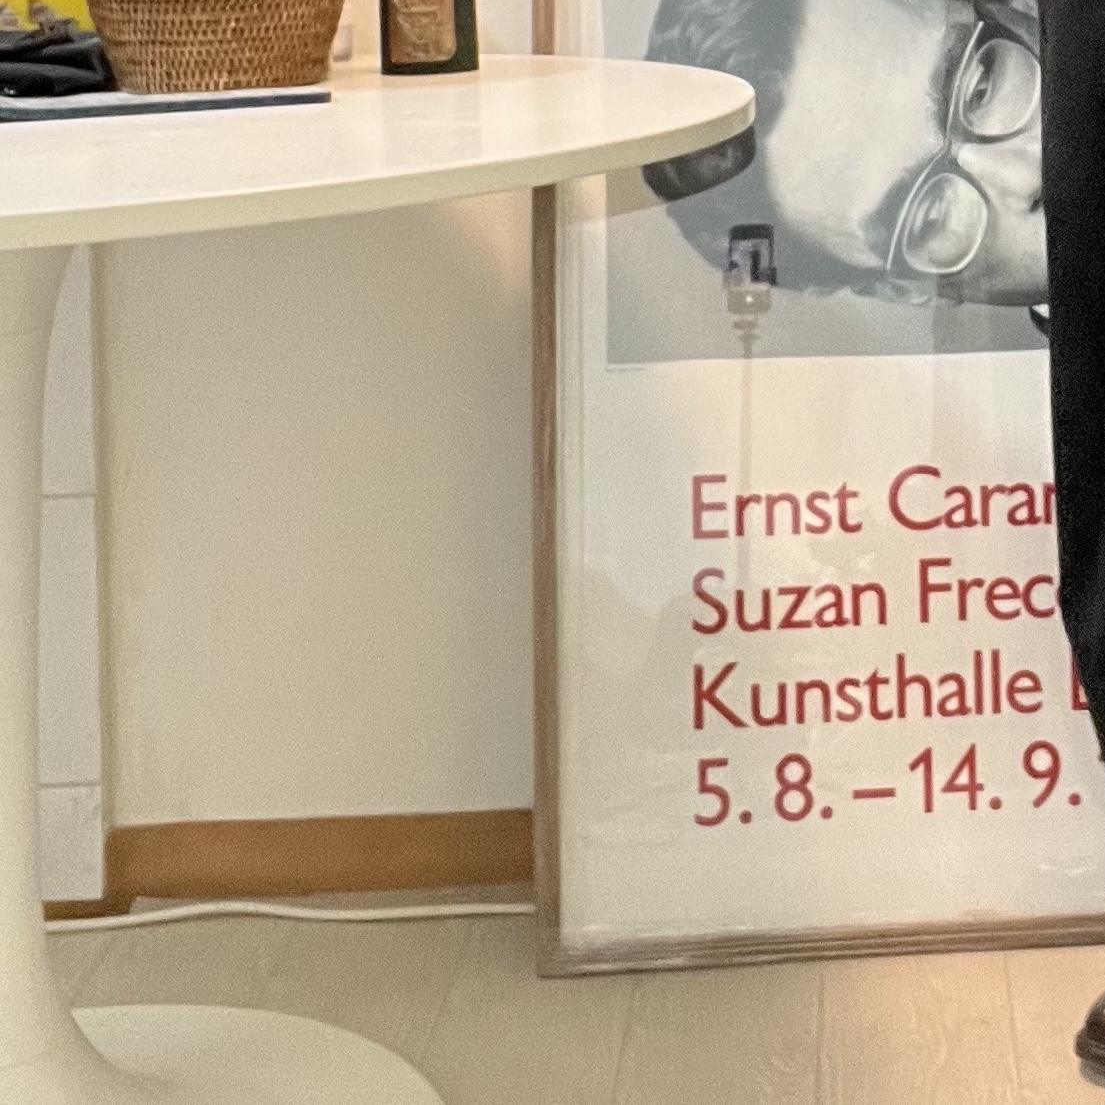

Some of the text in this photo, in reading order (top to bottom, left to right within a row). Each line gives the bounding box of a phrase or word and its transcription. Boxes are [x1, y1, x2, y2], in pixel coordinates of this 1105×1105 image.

[692, 473, 863, 540] Ernst
[691, 557, 1061, 635] Suzan Frec
[692, 649, 1044, 730] Kunsthalle
